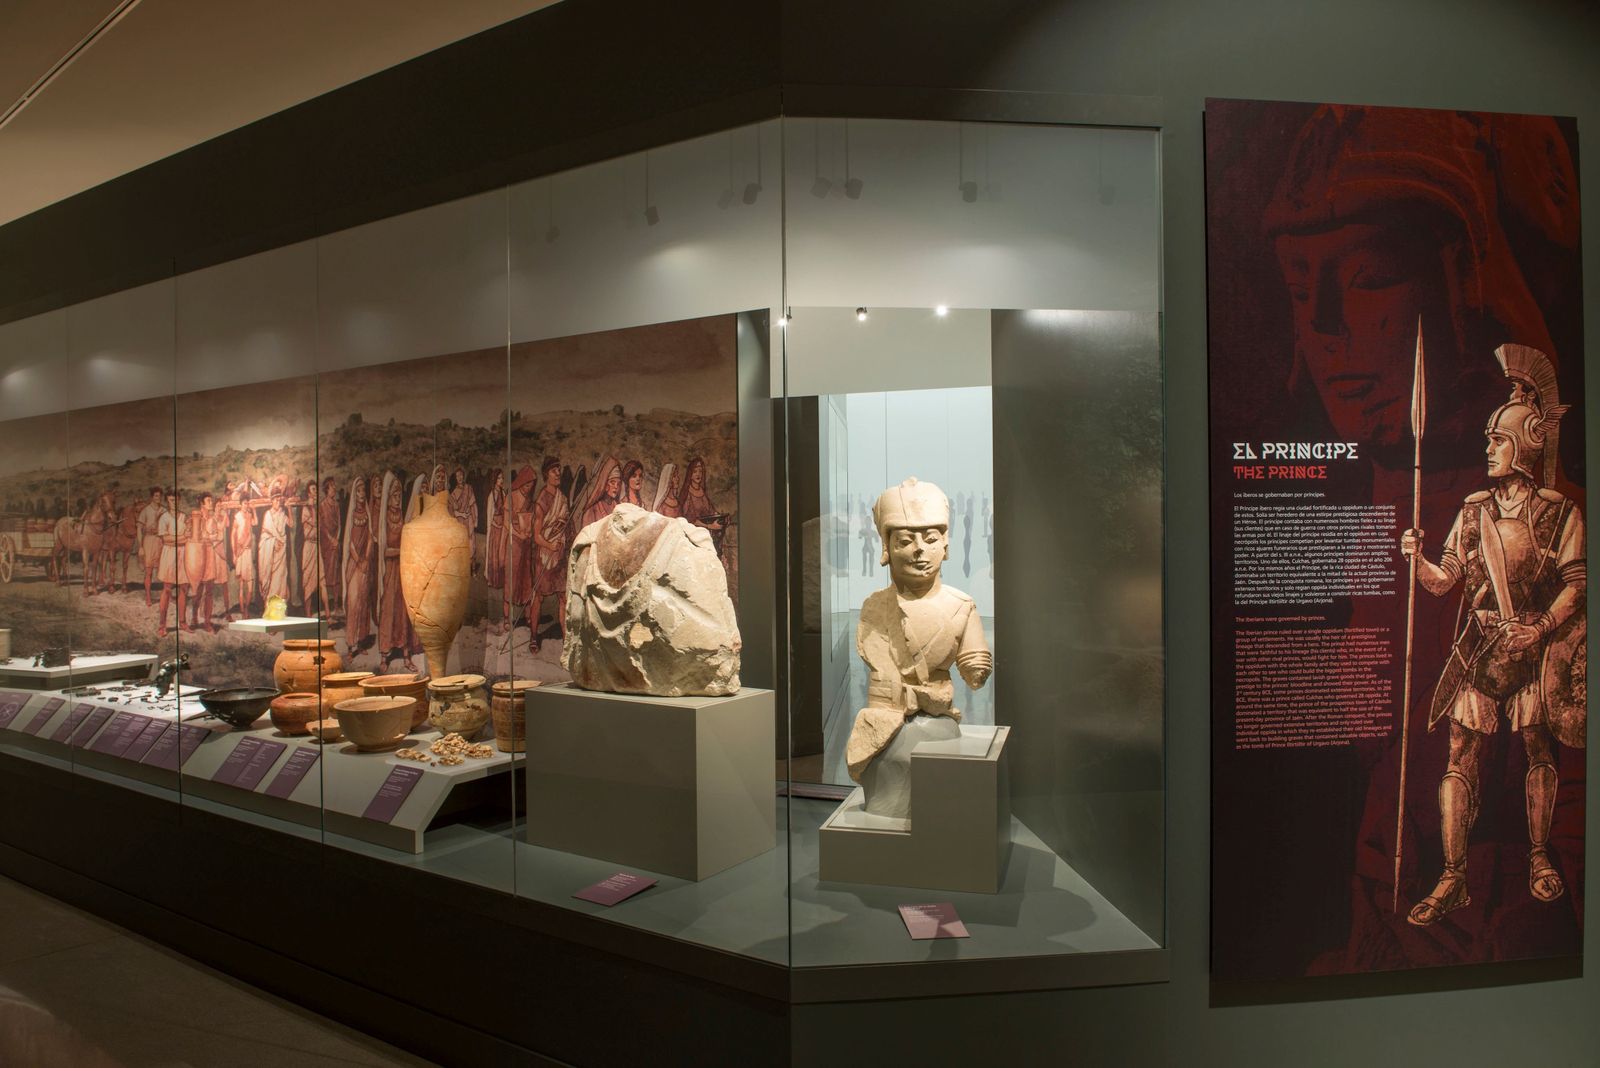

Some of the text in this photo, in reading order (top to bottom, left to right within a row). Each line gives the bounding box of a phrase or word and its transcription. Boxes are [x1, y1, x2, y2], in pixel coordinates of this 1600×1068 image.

[1233, 443, 1358, 459] EL PRINCIPE
[1233, 465, 1327, 479] THE PRINCE
